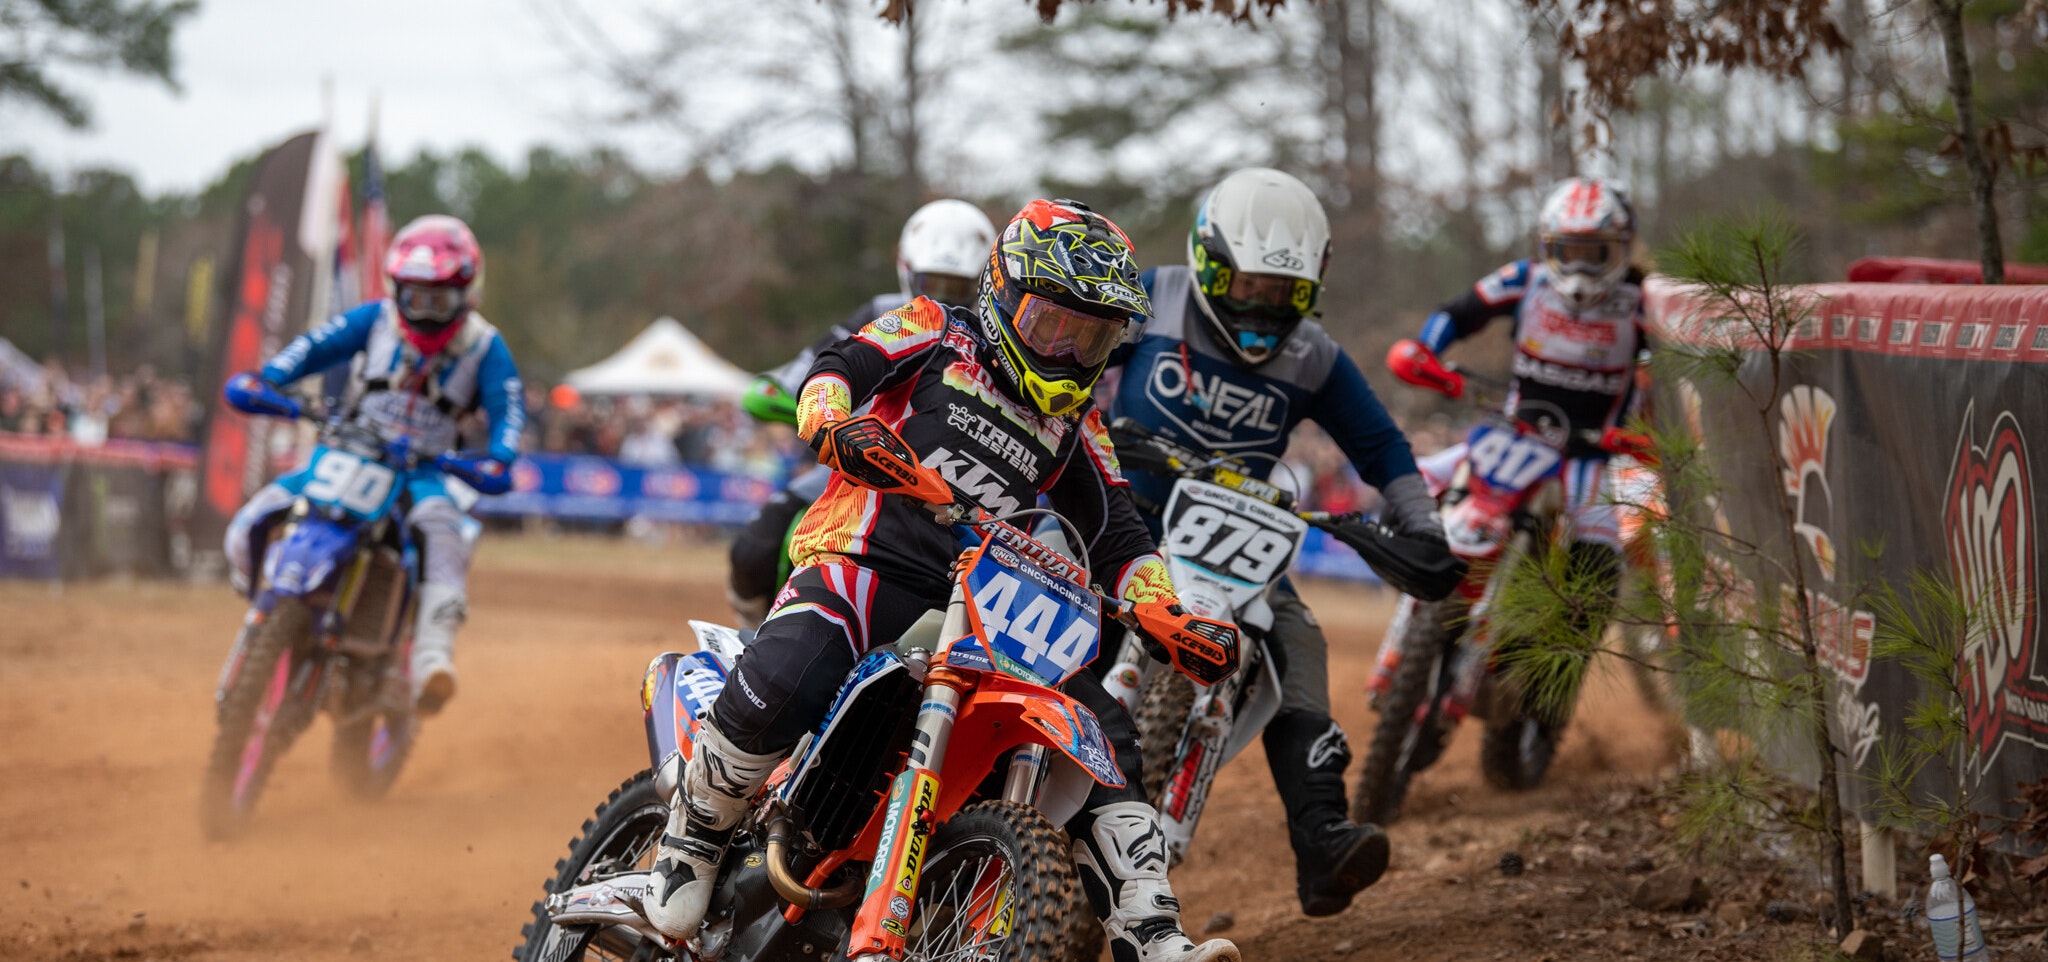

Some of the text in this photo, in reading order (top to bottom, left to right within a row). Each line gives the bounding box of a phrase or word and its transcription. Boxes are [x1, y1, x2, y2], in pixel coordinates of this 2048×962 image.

[980, 302, 999, 340] Arai
[1106, 284, 1137, 301] Arai
[944, 331, 974, 352] RK
[867, 451, 919, 486] ACERBIS
[967, 430, 1038, 484] JESTERS
[975, 414, 1040, 475] TRAIL
[1472, 429, 1562, 491] 417
[305, 450, 395, 512] 90
[919, 446, 1021, 521] KTM
[981, 520, 1081, 585] RENTHAL
[1169, 504, 1293, 584] 879
[1020, 563, 1099, 617] GNCCRACING.COM
[949, 650, 990, 664] STEEDE
[973, 570, 1098, 684] 444
[1169, 632, 1224, 662] ACERBIS
[869, 801, 899, 882] MOTOREX
[905, 780, 934, 876] DUNOP
